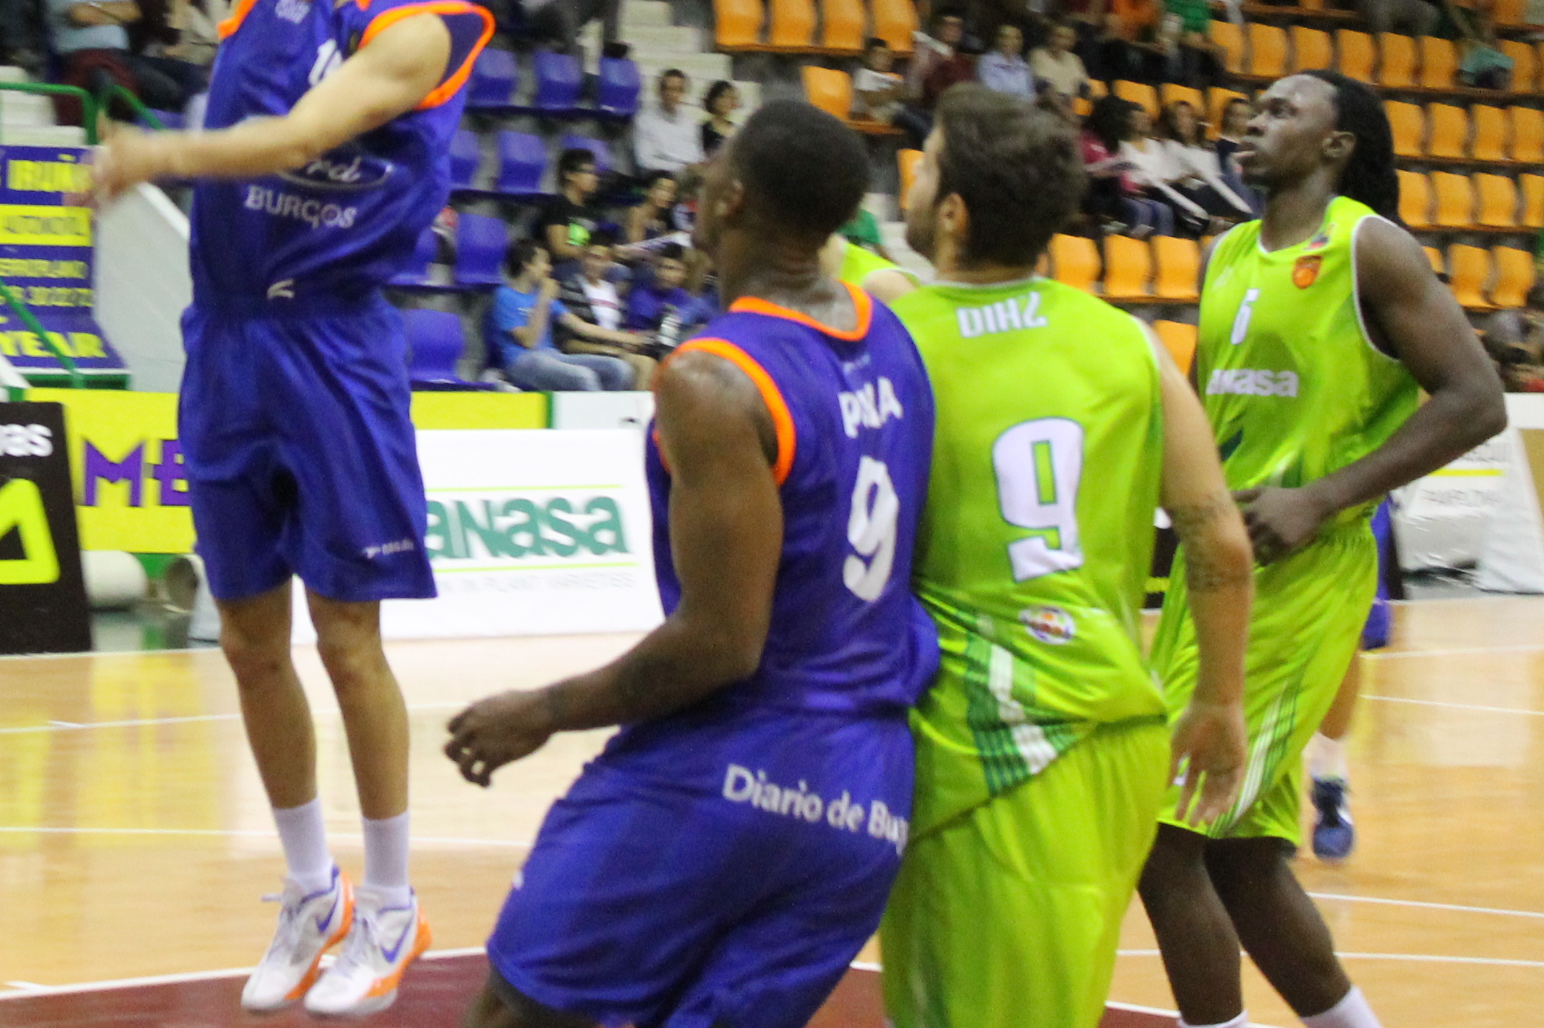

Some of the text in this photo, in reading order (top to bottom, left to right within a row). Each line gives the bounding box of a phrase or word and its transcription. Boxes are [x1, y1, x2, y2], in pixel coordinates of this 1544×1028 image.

[245, 185, 358, 230] BURGOS
[842, 455, 900, 602] 9
[991, 417, 1085, 582] 9
[722, 763, 824, 822] Diario
[826, 790, 865, 832] de
